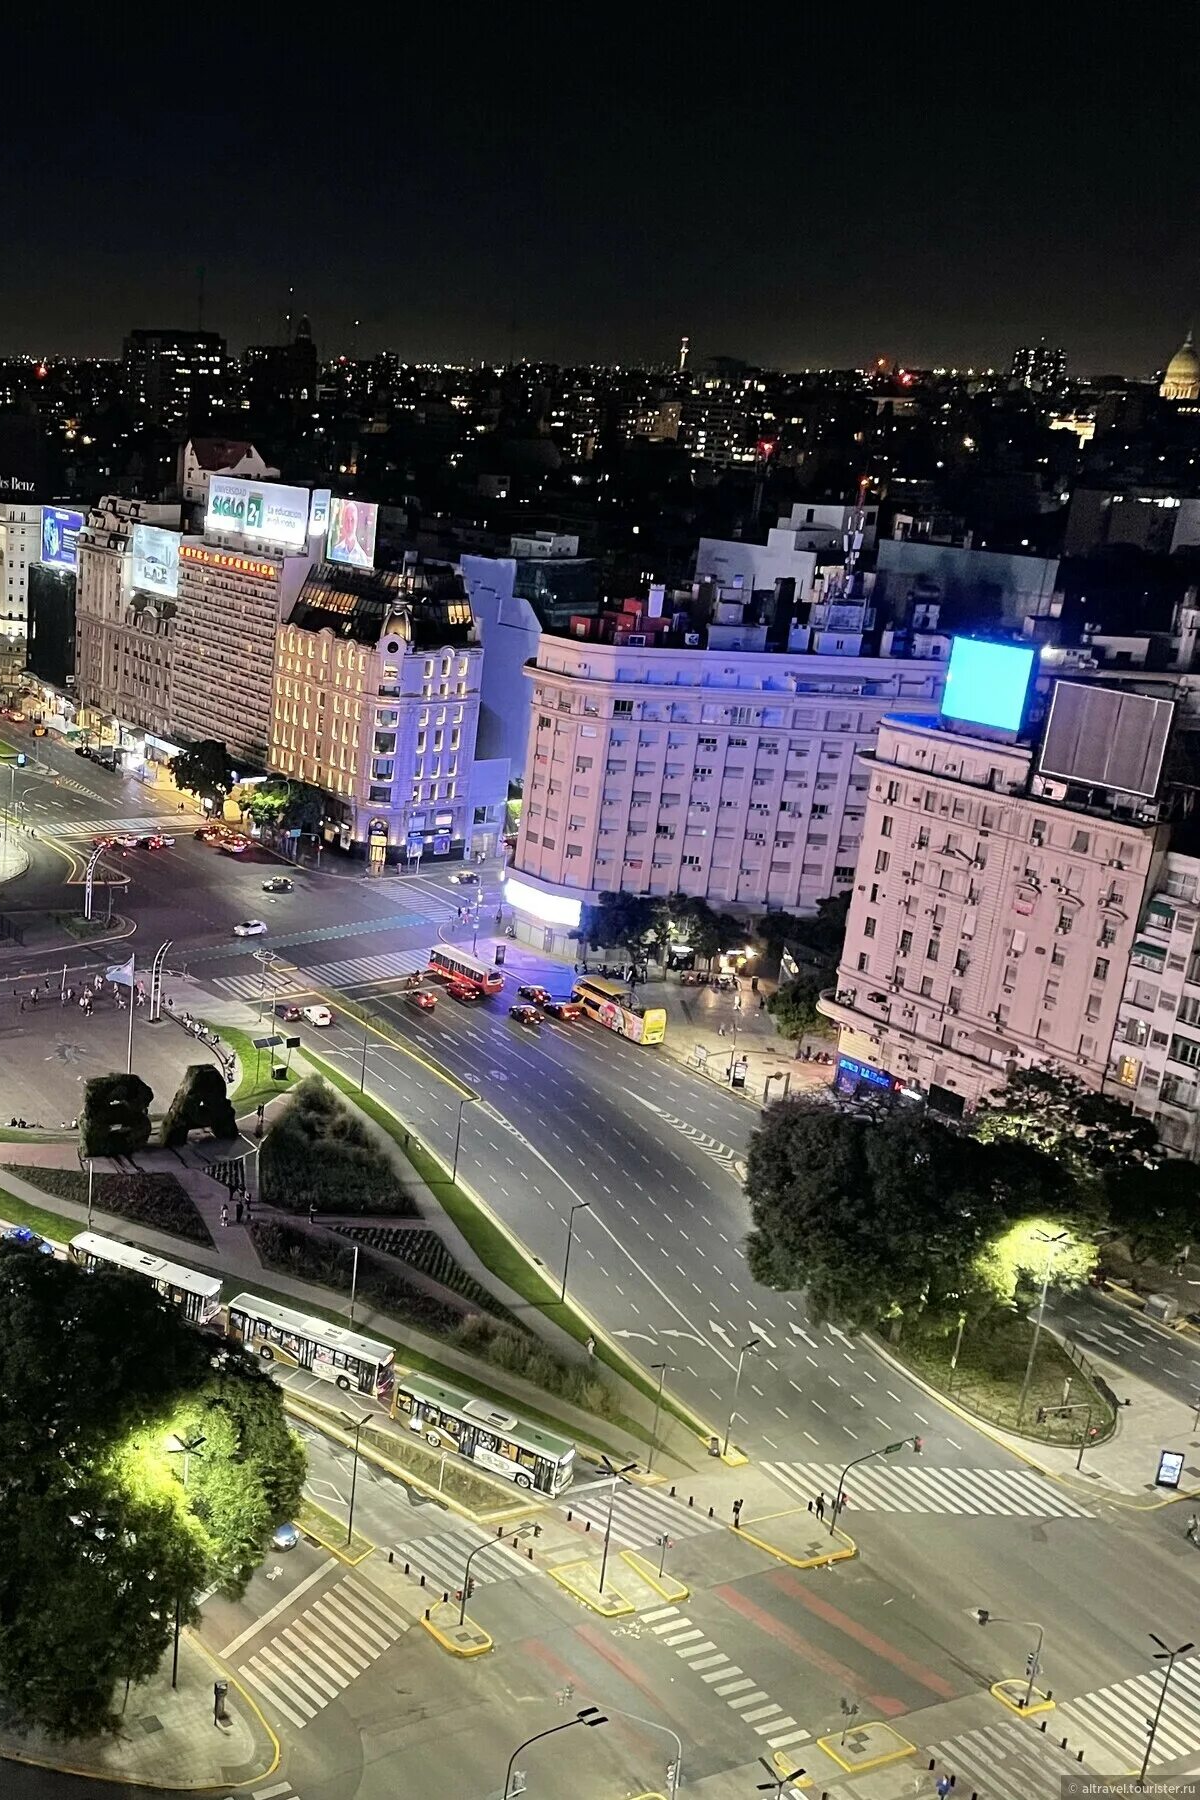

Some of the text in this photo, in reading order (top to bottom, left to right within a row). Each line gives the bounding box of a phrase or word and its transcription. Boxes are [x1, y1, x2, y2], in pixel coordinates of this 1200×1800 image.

[11, 476, 35, 492] Benz
[212, 495, 245, 519] SIGLO
[179, 547, 209, 561] HOTEL
